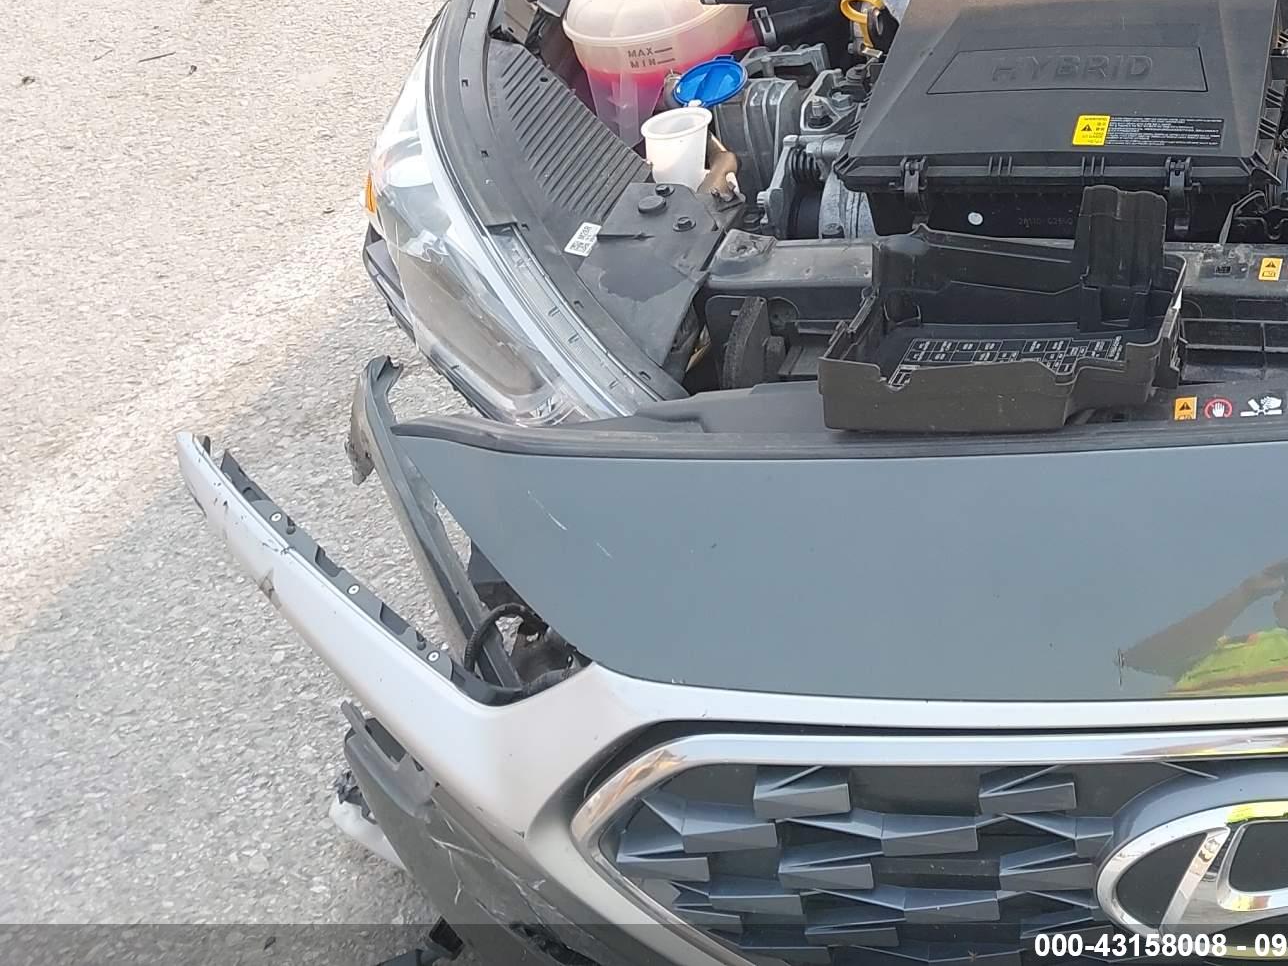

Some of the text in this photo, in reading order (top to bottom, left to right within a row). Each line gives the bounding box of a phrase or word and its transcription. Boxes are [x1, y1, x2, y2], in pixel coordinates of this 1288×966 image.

[627, 47, 654, 58] MAX
[630, 58, 657, 69] MIN
[991, 54, 1154, 82] HYBRID
